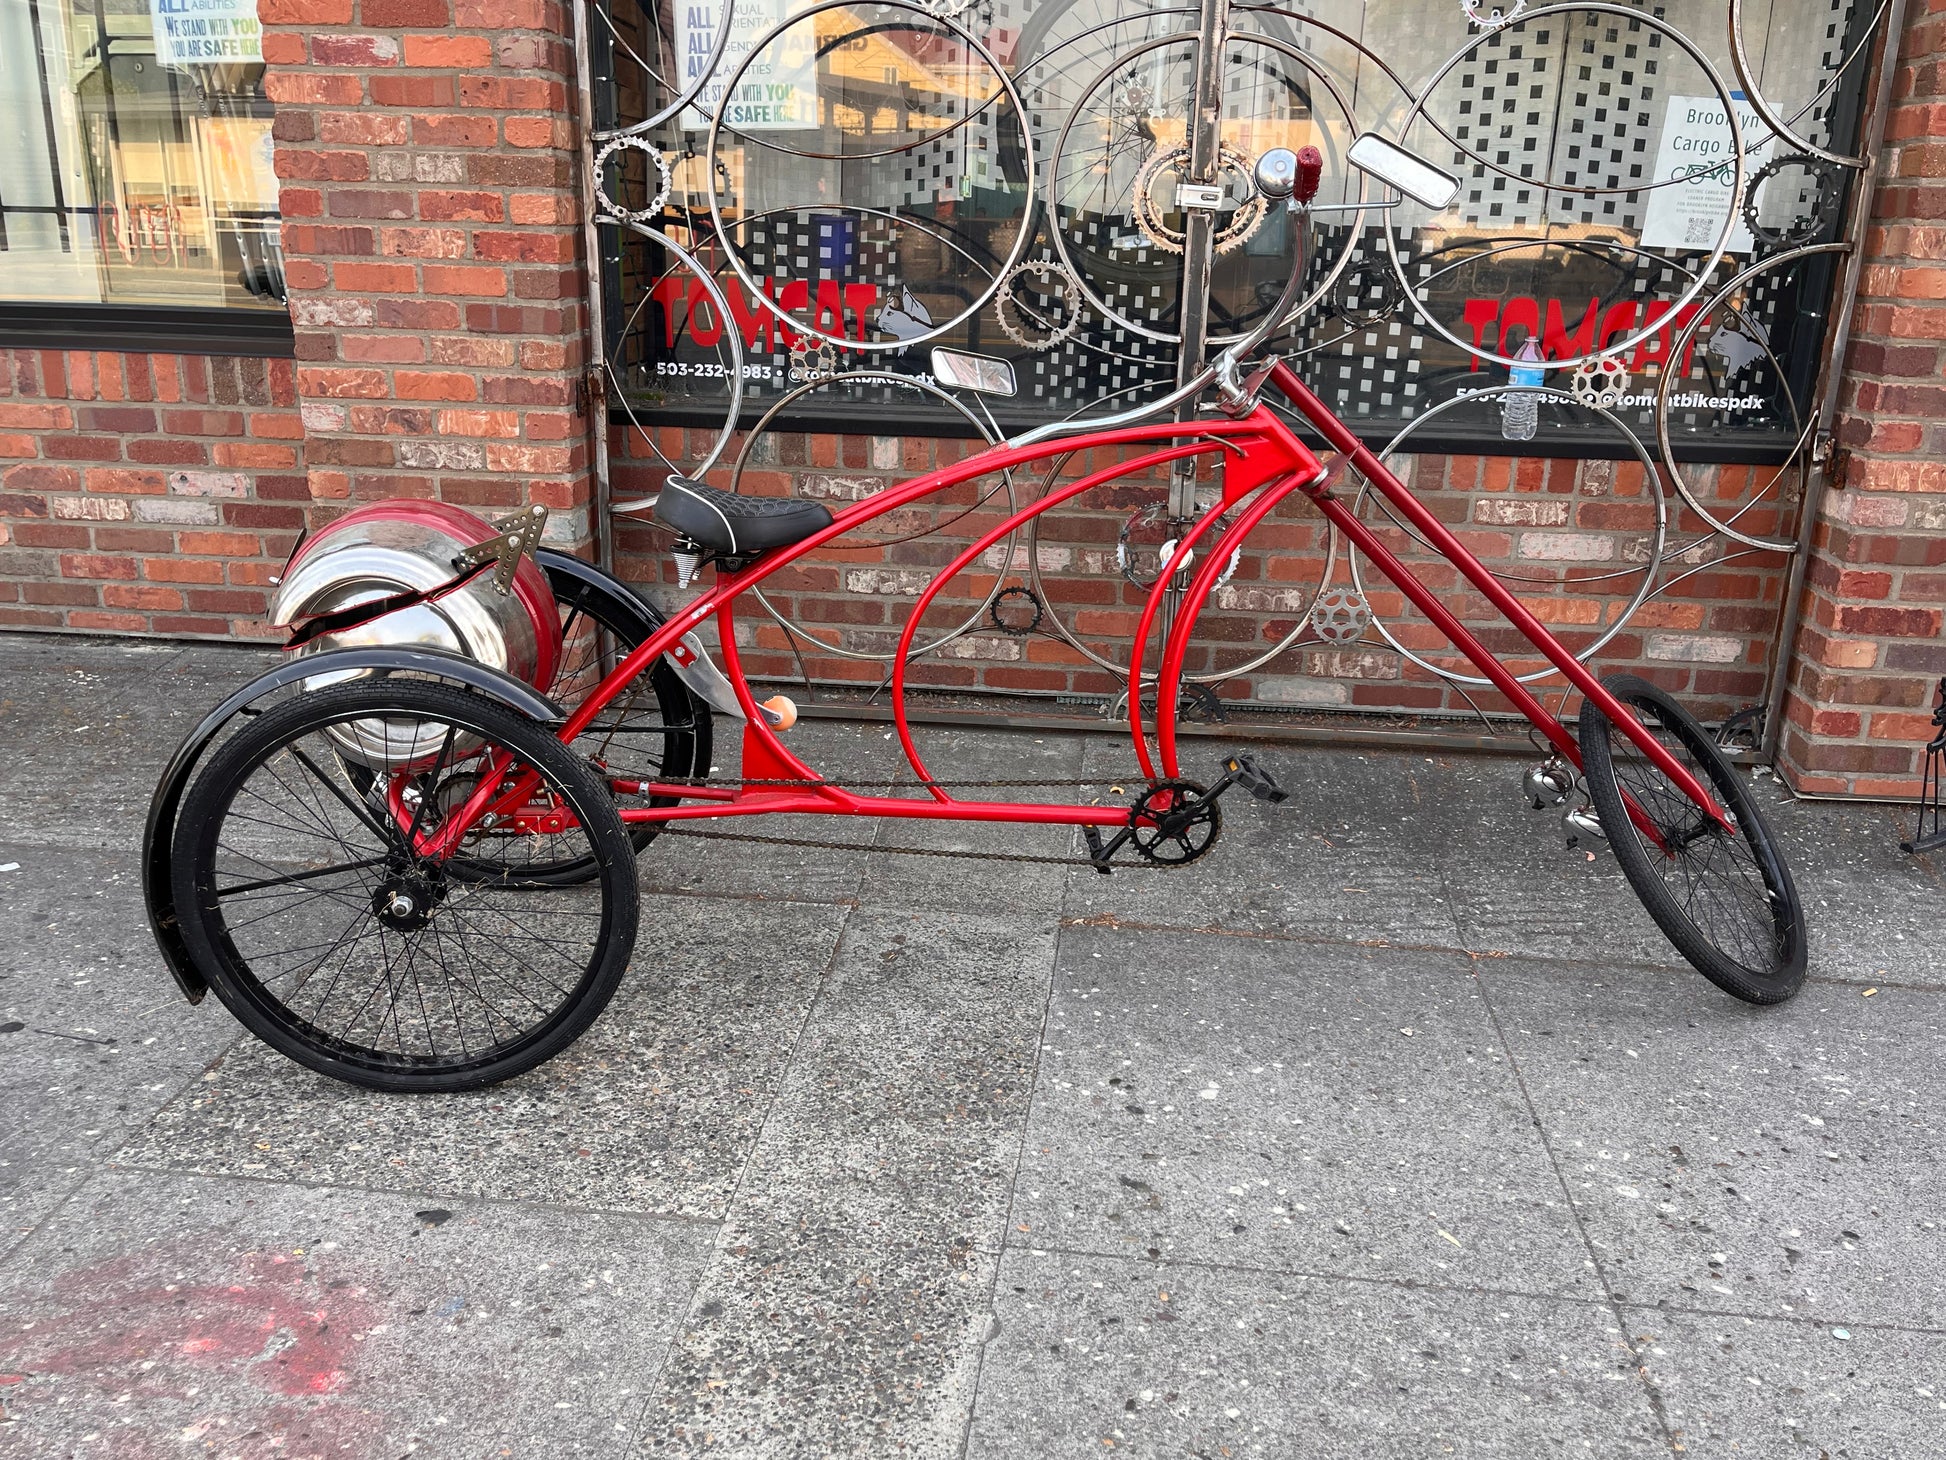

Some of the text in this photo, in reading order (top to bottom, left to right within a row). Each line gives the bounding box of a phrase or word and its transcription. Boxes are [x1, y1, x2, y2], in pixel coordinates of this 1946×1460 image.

[687, 3, 764, 29] ALL SXUAL
[181, 18, 207, 37] STAND
[208, 19, 229, 36] WITH
[231, 18, 259, 35] YOU
[187, 40, 203, 57] ARE
[203, 39, 239, 57] SAFE
[240, 39, 260, 56] HERE
[688, 32, 714, 55] ALL
[687, 55, 772, 78] AL ABITIES
[712, 84, 739, 102] STD
[741, 84, 763, 102] WITH
[765, 84, 795, 102] YOU
[734, 105, 771, 122] SAFE
[774, 105, 795, 122] HERE
[1686, 108, 1760, 131] Brooyn
[1672, 136, 1763, 156] Cargo Bke
[651, 275, 878, 356] TOMCAT
[1463, 296, 1712, 379] TOMCAT
[656, 362, 772, 380] 503-232-983
